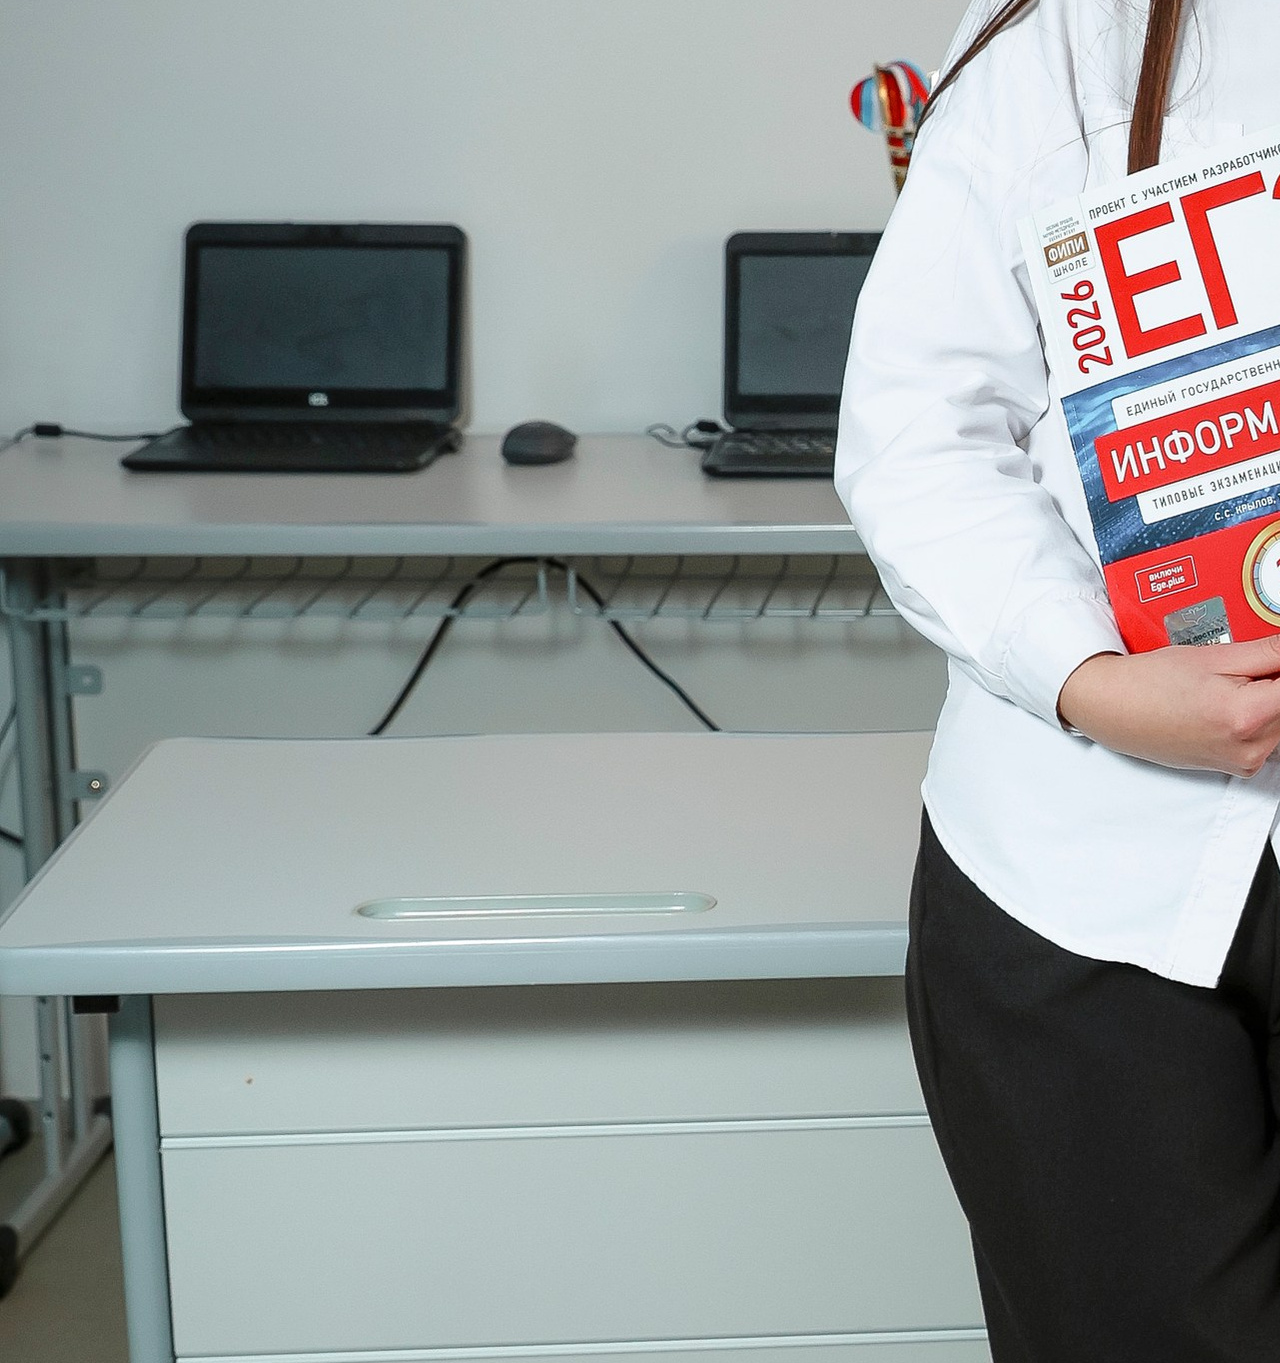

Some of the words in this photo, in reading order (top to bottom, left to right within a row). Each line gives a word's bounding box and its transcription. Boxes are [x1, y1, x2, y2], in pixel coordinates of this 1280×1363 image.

[1088, 197, 1127, 220] ПРОЕКТ
[1131, 193, 1138, 204] С
[1142, 173, 1198, 203] УЧАСТИЕМ
[1048, 235, 1086, 262] ФИПИ
[1053, 257, 1088, 278] ШКОЛЕ
[1060, 280, 1113, 374] 2026
[1126, 389, 1177, 417] ЕДИНЫЙ
[1152, 483, 1205, 510] ТИПОВЫЕ
[1236, 496, 1276, 515] КРЫЛОВ,
[1150, 575, 1186, 593] Ege.plus
[1193, 626, 1225, 643] ДОСТУПА
